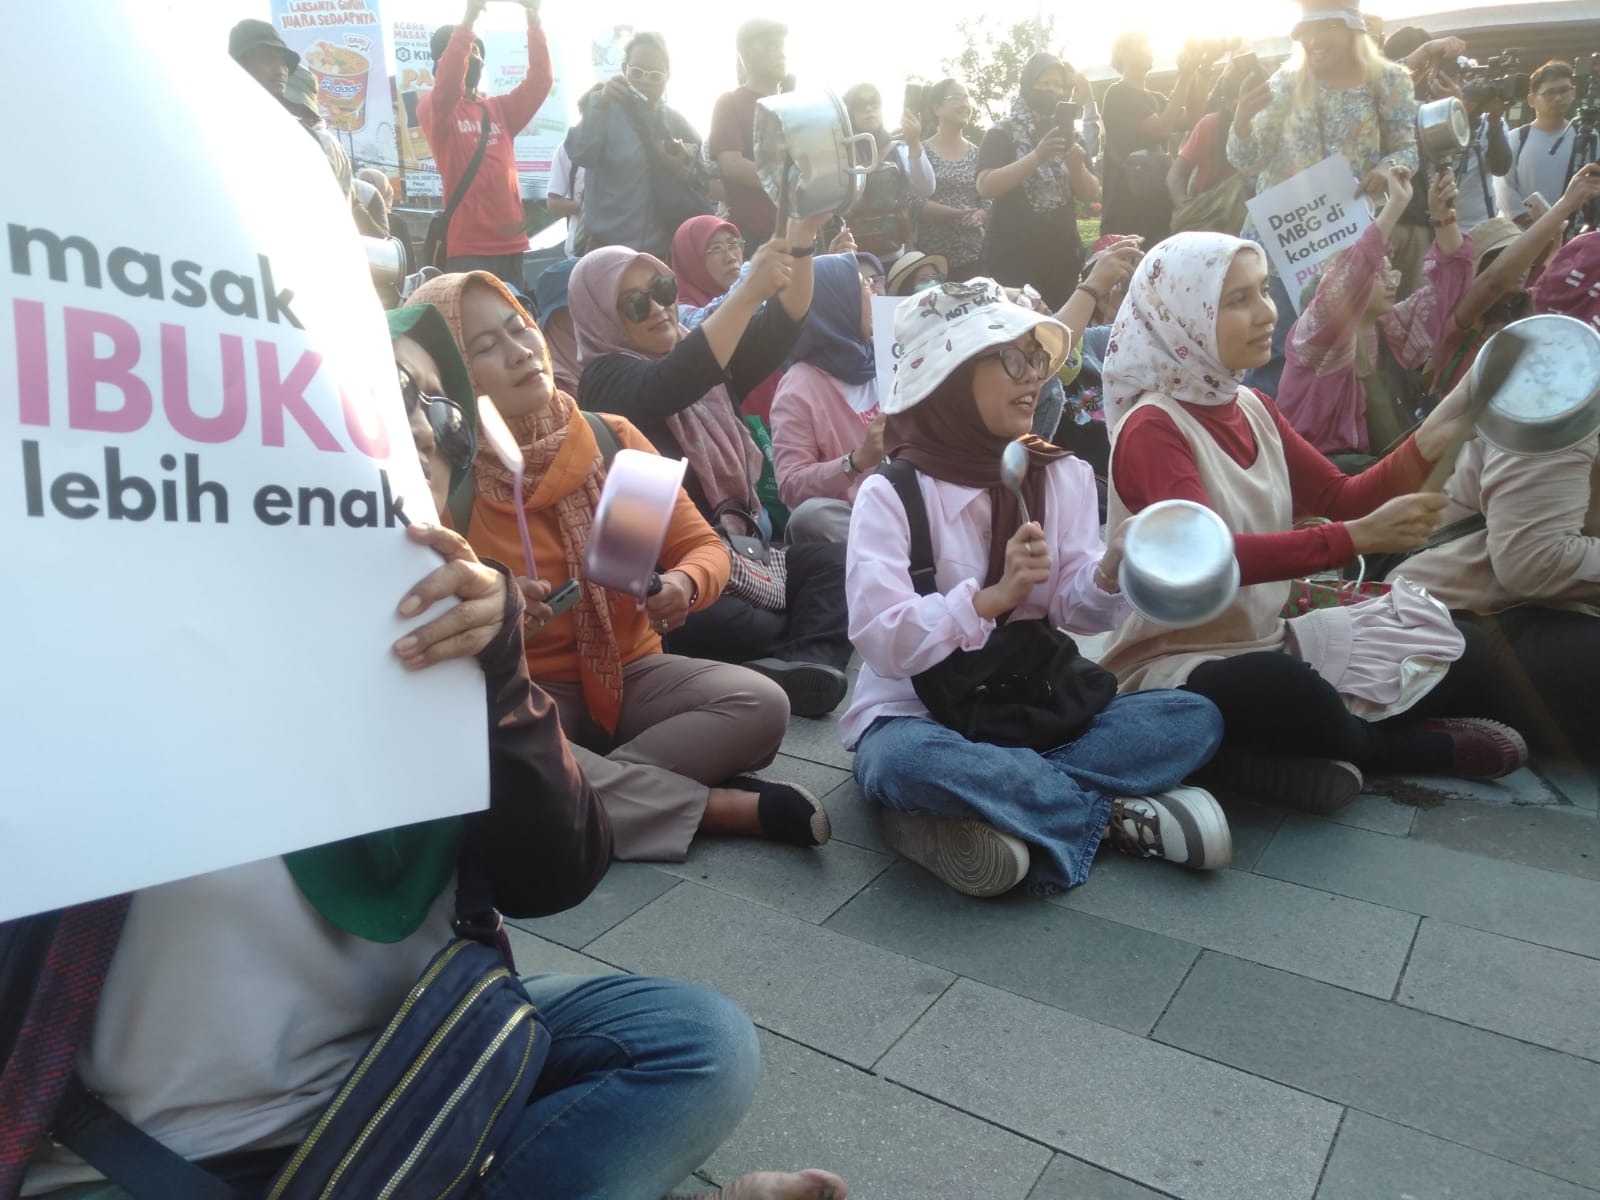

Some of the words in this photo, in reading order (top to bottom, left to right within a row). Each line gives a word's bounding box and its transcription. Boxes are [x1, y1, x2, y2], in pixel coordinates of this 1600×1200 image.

[282, 14, 316, 28] JUARA
[1267, 193, 1328, 231] Dapur
[1277, 215, 1323, 248] MBG
[1326, 203, 1346, 223] di
[1285, 221, 1358, 264] kotamu
[8, 222, 305, 330] masak
[21, 439, 229, 524] lebih
[252, 469, 412, 529] enak
